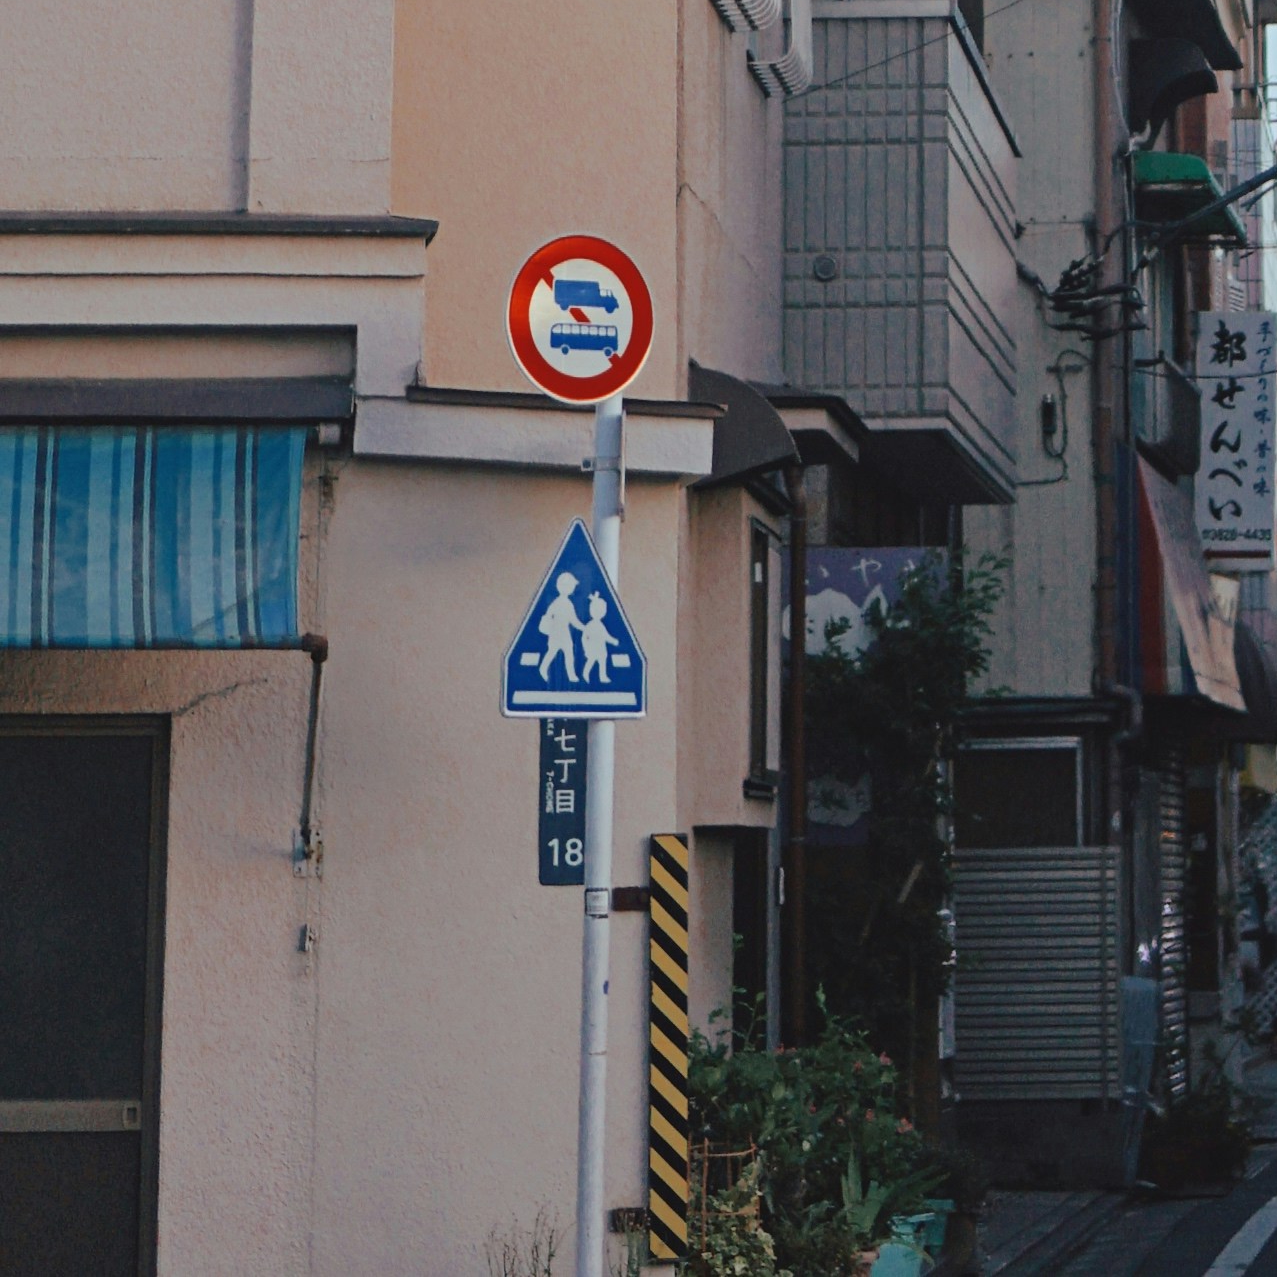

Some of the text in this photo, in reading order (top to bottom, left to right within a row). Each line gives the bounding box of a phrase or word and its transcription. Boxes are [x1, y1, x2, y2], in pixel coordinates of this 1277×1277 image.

[1208, 319, 1258, 522] 都せんべい
[553, 717, 577, 814] 七丁目
[547, 837, 584, 868] 18
